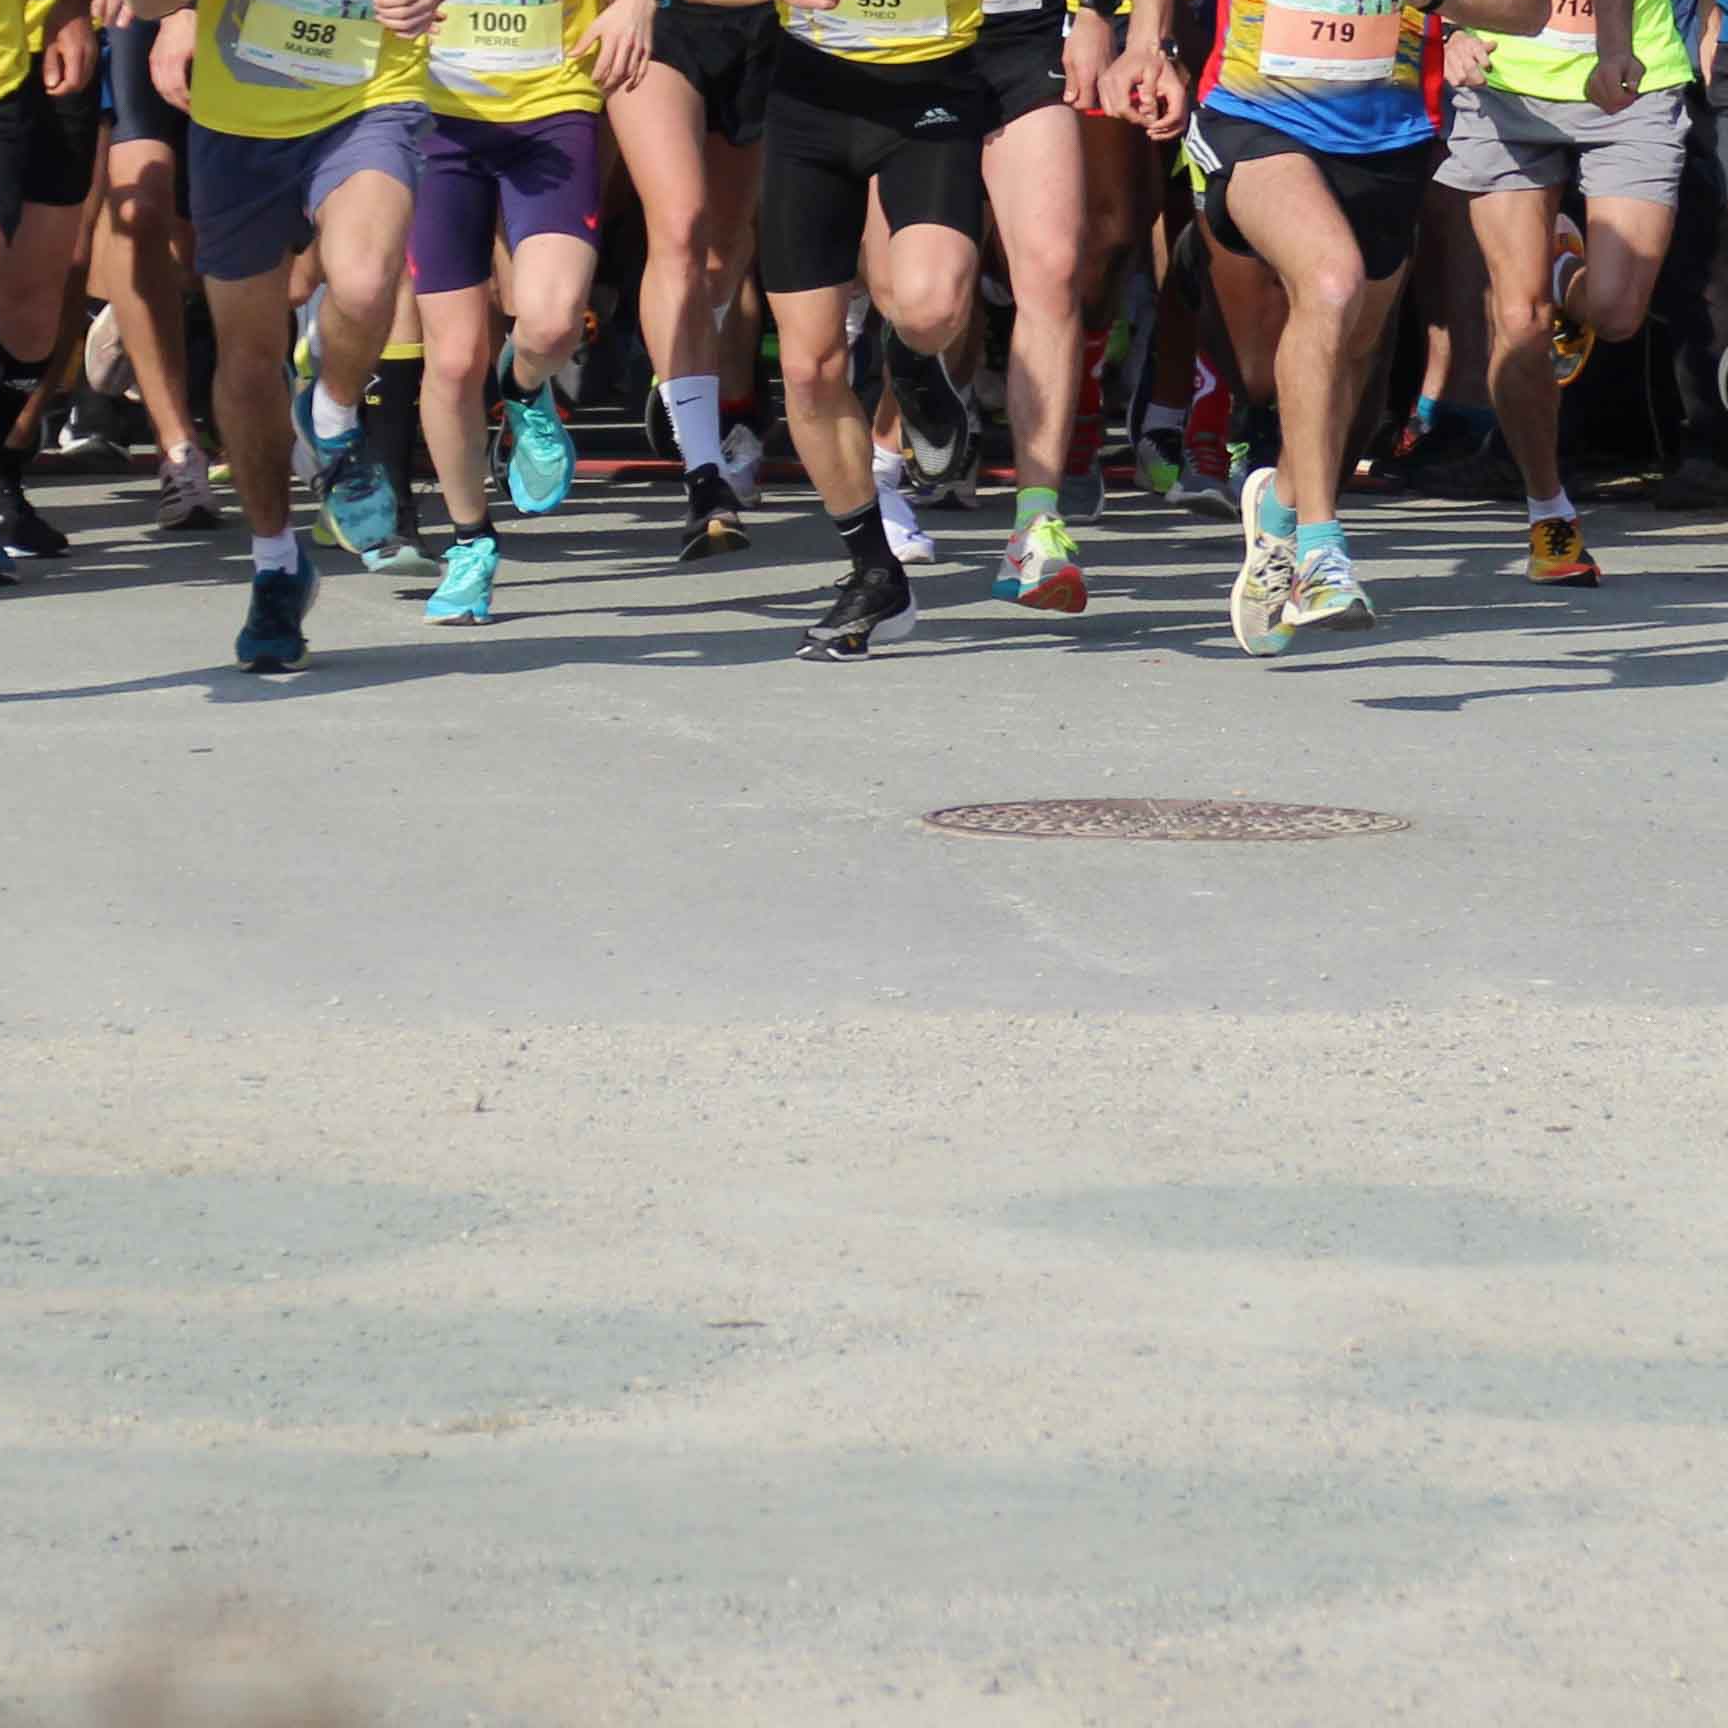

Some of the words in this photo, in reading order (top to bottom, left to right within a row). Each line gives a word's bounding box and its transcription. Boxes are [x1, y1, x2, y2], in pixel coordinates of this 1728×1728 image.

[290, 20, 337, 44] 958
[468, 12, 527, 33] 1000
[1310, 20, 1355, 43] 719
